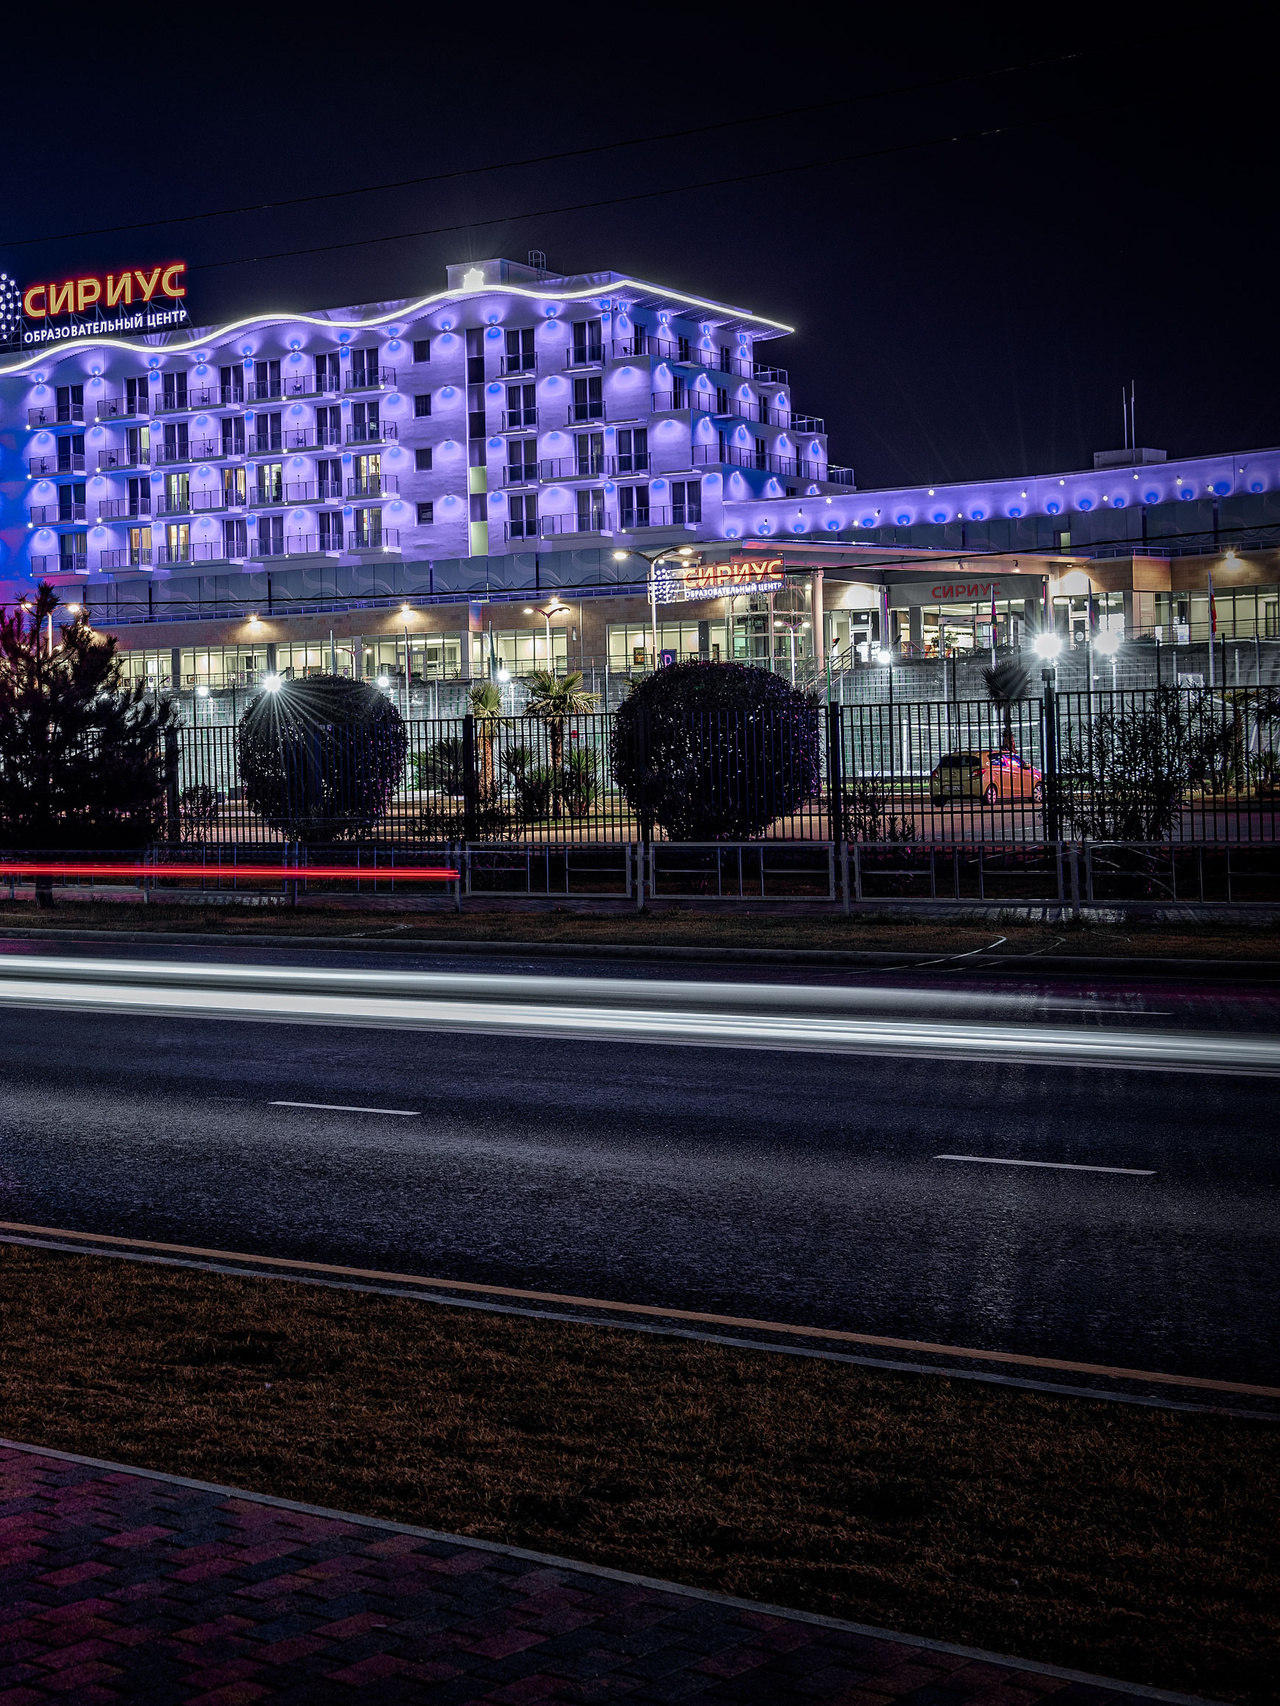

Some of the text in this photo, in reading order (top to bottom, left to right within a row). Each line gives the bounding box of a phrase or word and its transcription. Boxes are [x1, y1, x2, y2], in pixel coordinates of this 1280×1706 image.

[24, 264, 185, 317] СИРИУС
[24, 310, 187, 343] ОБРАЗОВАТЕЛЬНЫЙ ЦЕНТР
[683, 559, 784, 588] СИРИУС
[685, 582, 783, 599] ОБРАЗОВАТЕЛЬНЫЙ ЦЕНТР
[931, 582, 1001, 598] СИРИУС
